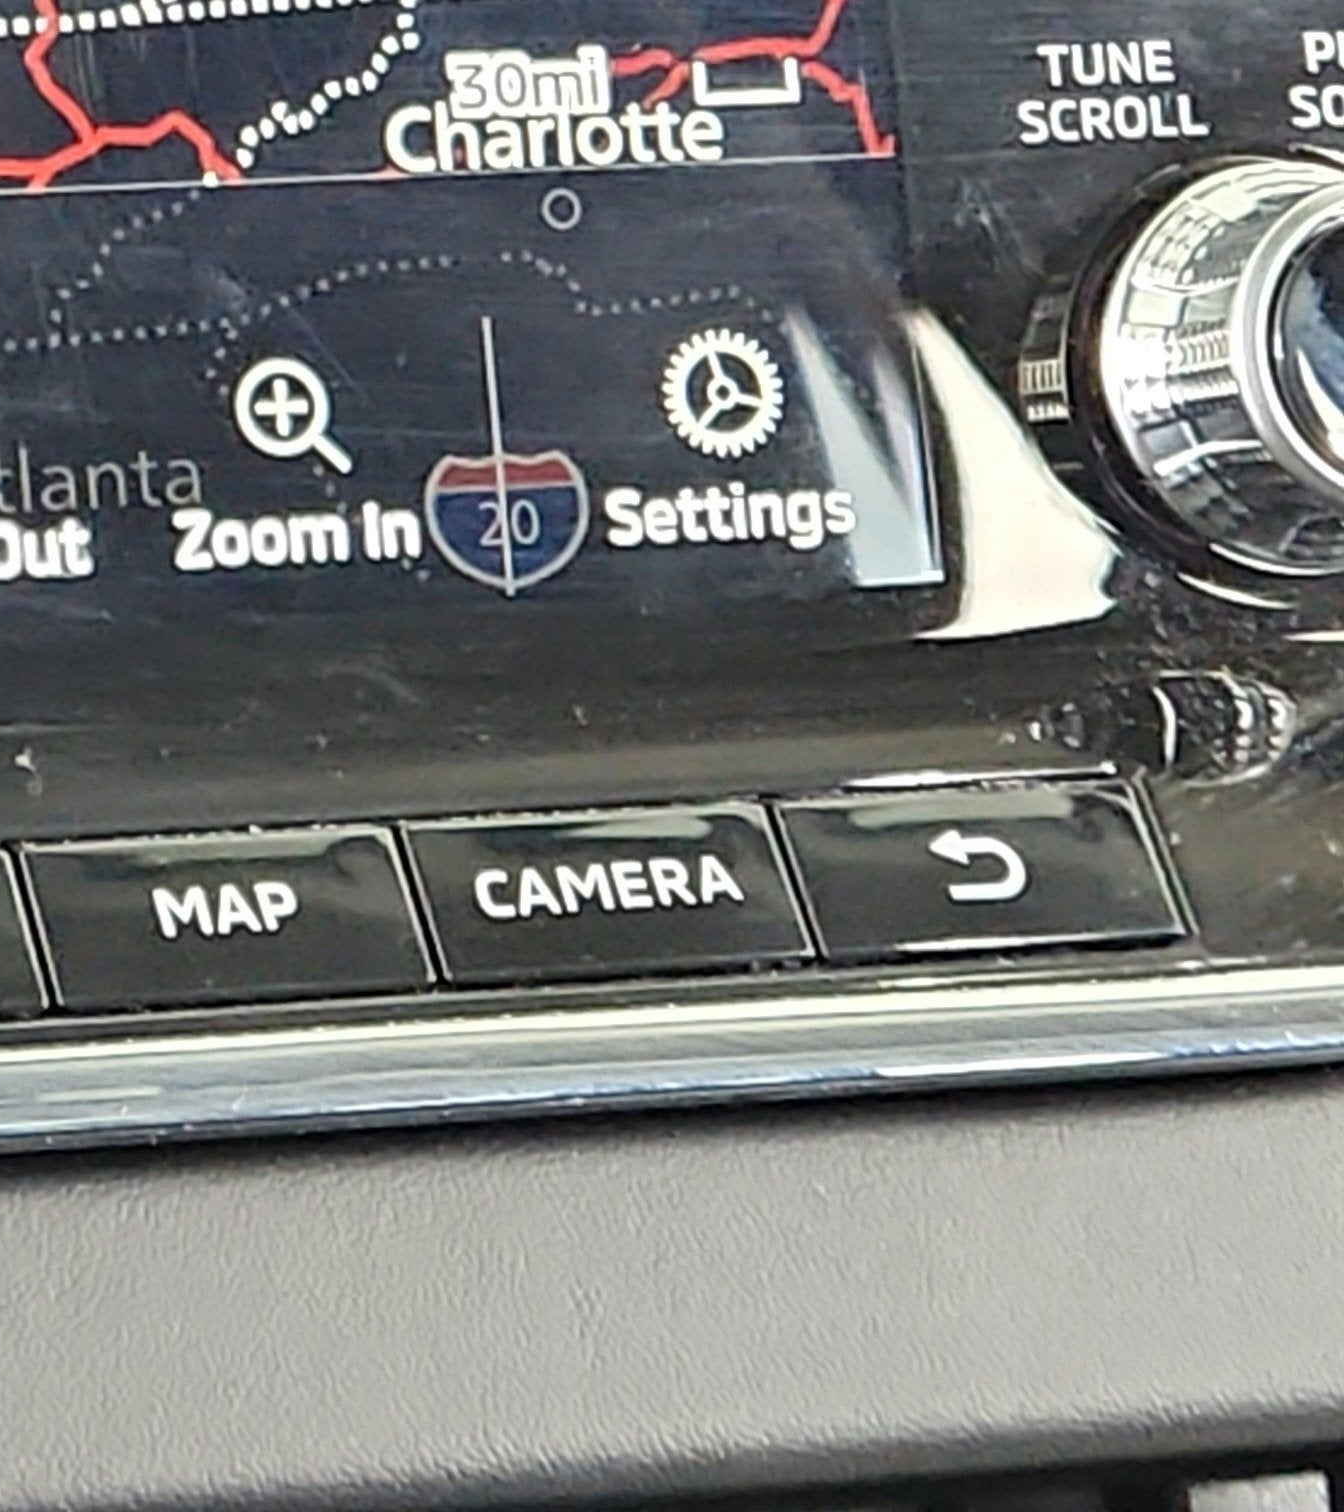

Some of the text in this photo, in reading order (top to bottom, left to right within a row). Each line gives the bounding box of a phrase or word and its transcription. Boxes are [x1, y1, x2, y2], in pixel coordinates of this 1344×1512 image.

[448, 46, 605, 113] 30mi
[1036, 39, 1176, 87] TUNE
[383, 100, 725, 172] Charlotte
[1017, 94, 1211, 145] SCROLL
[171, 499, 421, 572] Zoom In
[478, 499, 541, 547] 20
[605, 482, 857, 549] Settings
[151, 879, 298, 939] MAP
[471, 853, 746, 922] CAMERA
